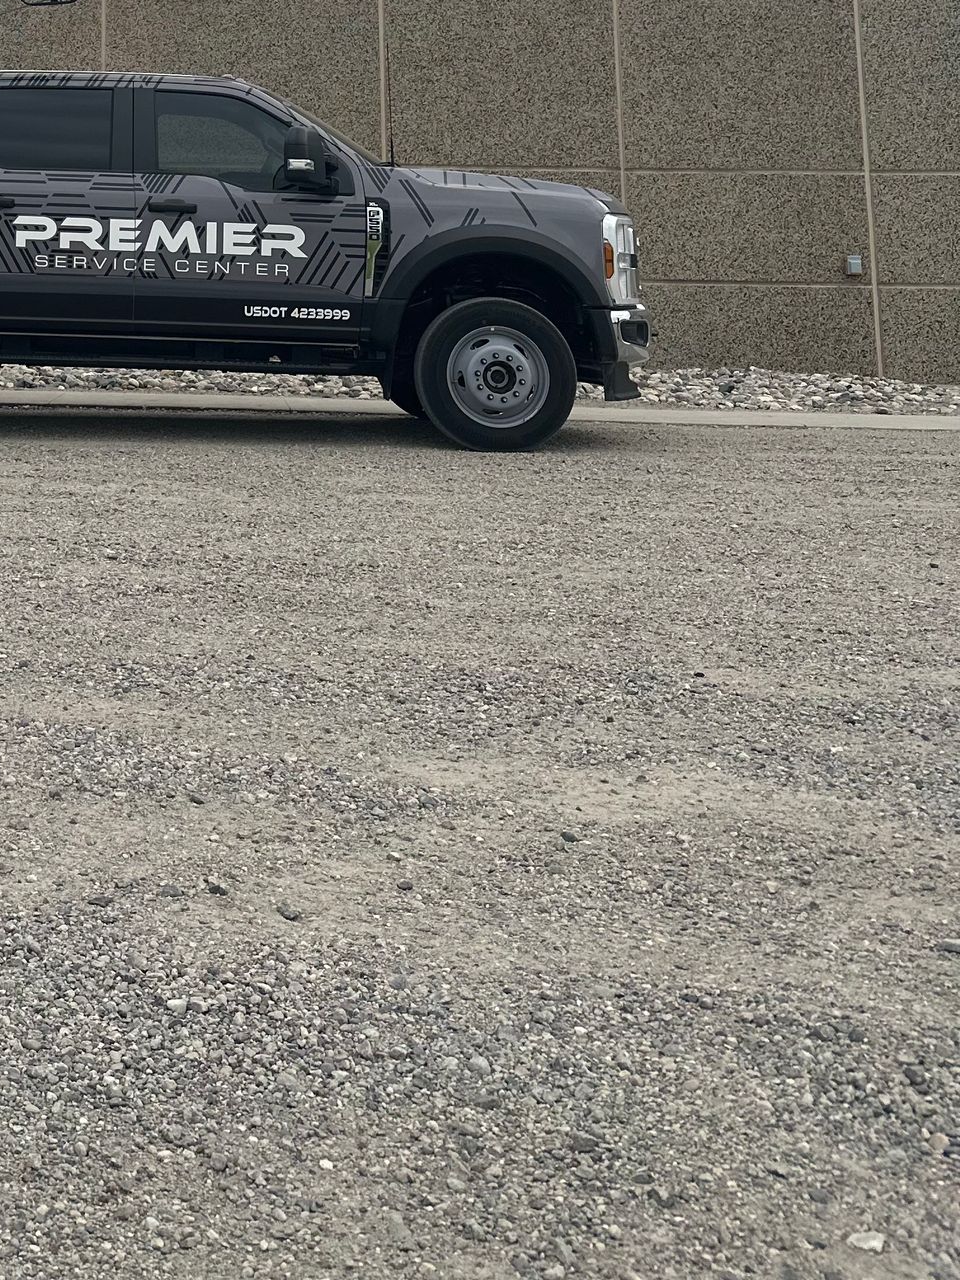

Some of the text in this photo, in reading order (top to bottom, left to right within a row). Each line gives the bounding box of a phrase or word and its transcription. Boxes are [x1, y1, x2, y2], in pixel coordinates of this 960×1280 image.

[12, 215, 308, 258] PREMIER
[34, 254, 290, 277] SERVICE CENTER
[244, 305, 351, 321] USDOT 4233999
